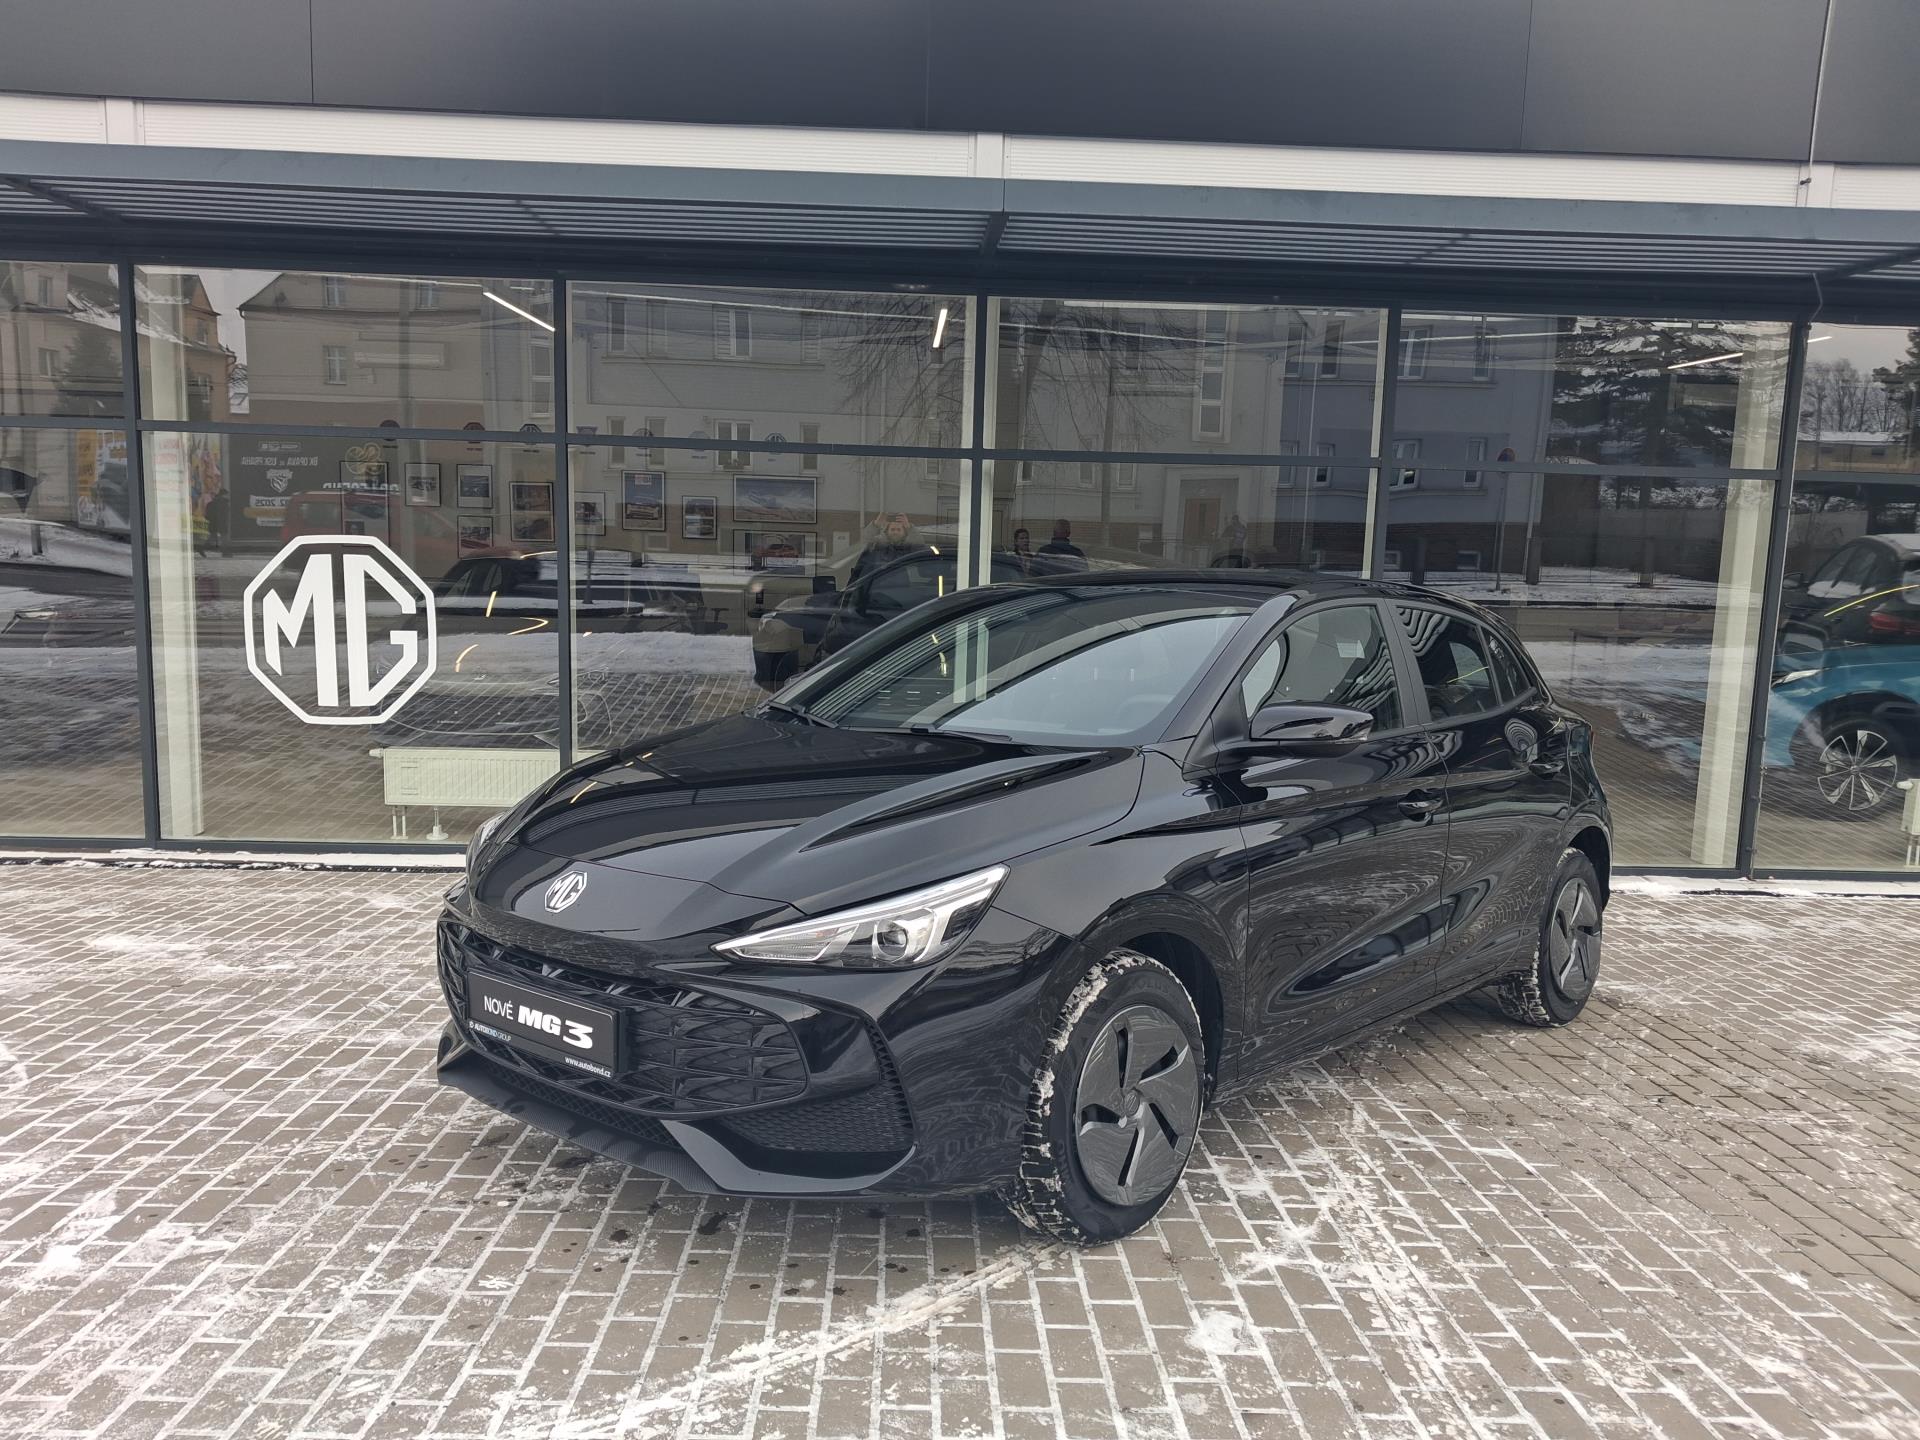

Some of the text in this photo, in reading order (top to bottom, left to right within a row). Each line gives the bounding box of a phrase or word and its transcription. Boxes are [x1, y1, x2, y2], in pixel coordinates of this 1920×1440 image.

[262, 552, 418, 707] MG
[547, 873, 584, 909] MG
[483, 995, 594, 1050] NOVÉ MG 3
[564, 1056, 612, 1078] www.autobond.cz
